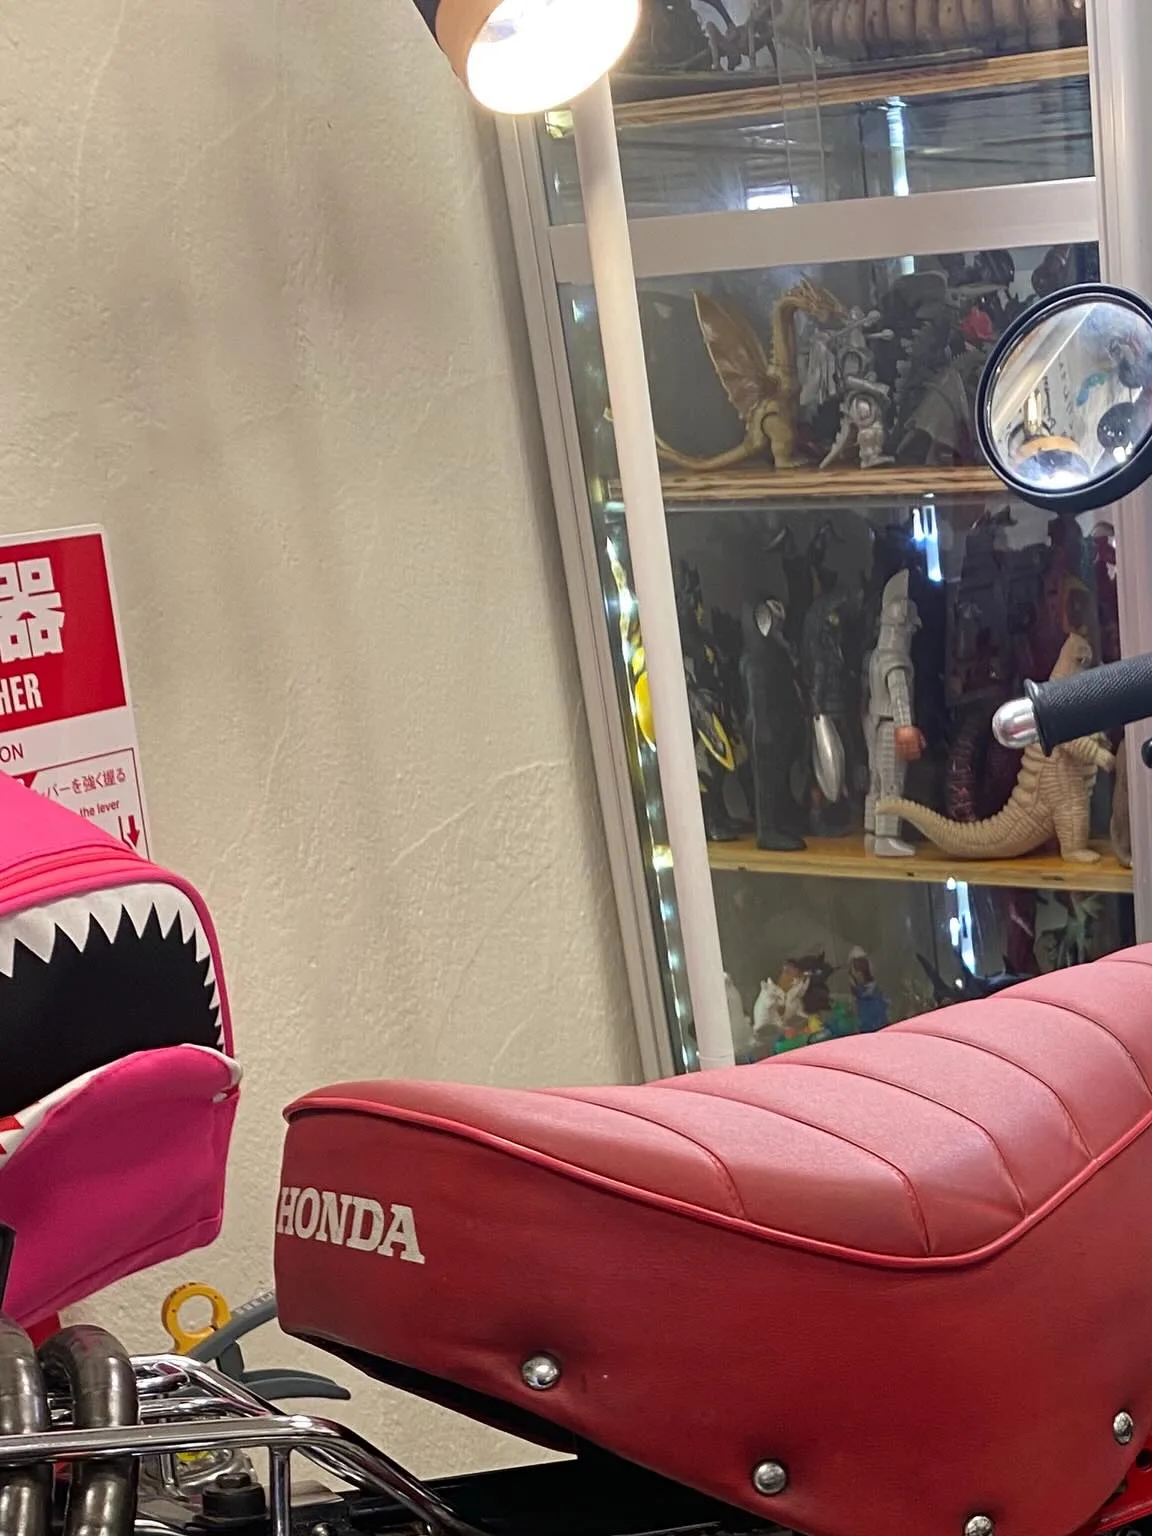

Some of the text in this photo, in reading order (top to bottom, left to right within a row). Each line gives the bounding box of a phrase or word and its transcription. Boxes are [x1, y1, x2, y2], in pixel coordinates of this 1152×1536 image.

[38, 767, 126, 800] バーを強く握る
[80, 800, 120, 817] the lever
[276, 1187, 425, 1265] HONDA
